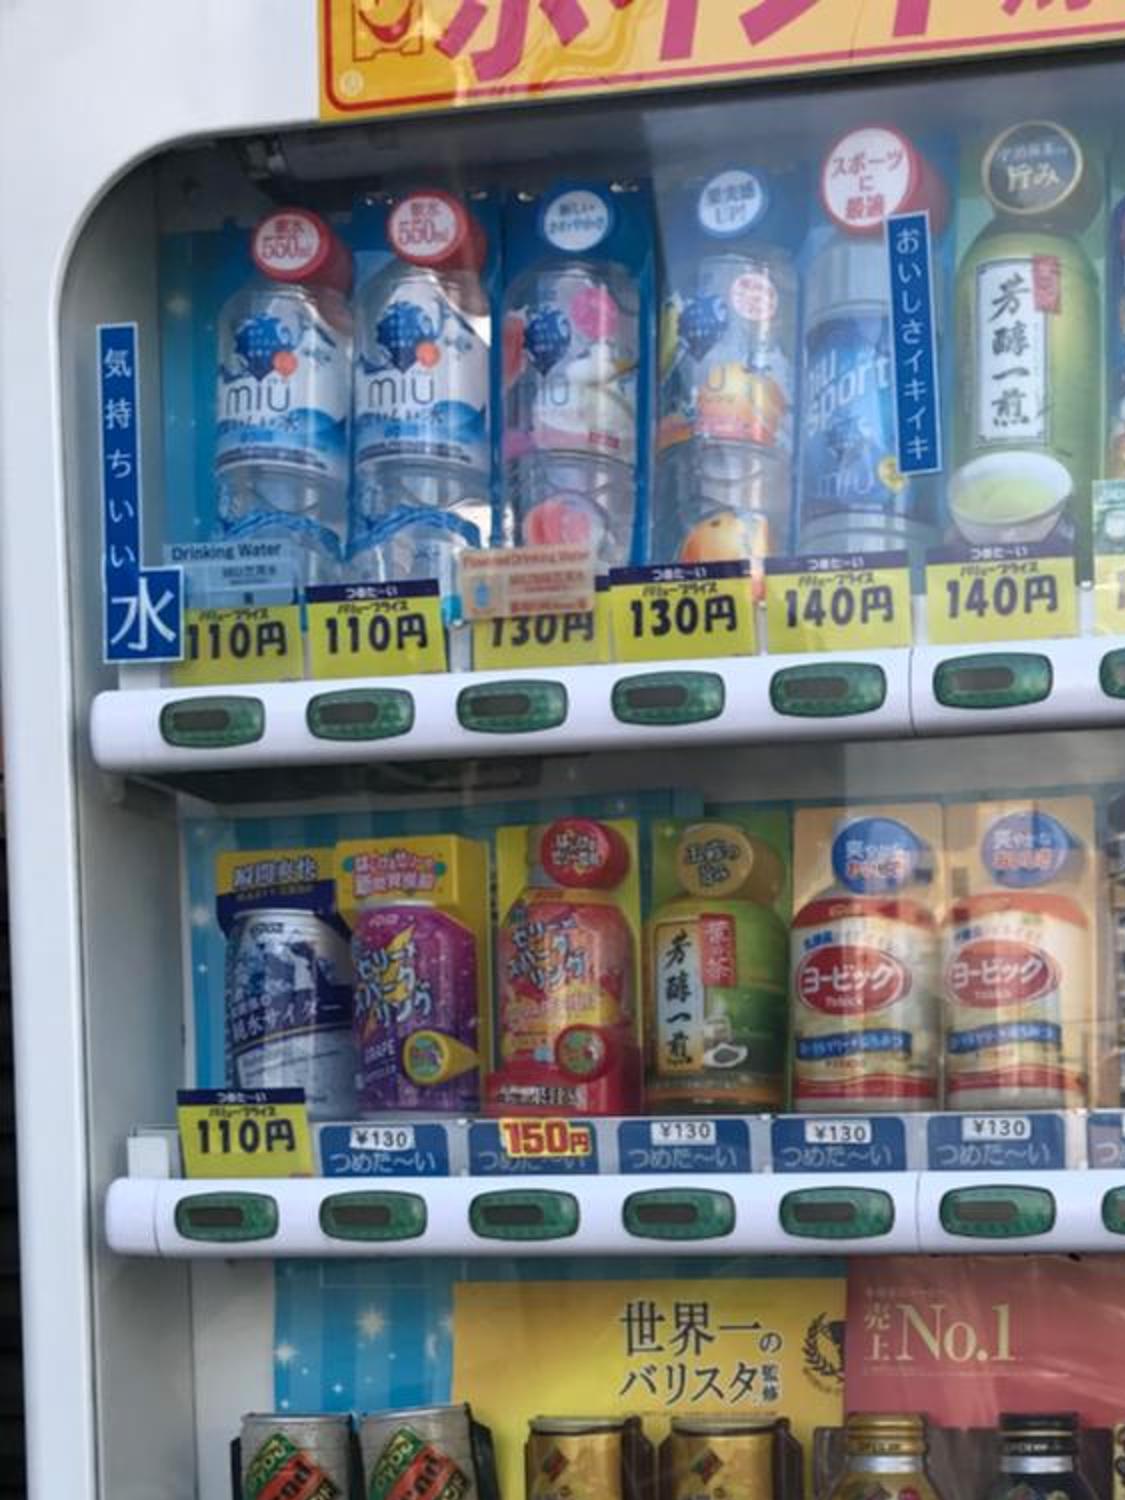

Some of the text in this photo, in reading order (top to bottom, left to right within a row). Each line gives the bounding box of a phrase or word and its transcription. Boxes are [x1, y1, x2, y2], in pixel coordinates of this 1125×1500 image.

[831, 149, 904, 178] スポーツ
[858, 175, 874, 191] に
[895, 229, 930, 460] おいしさイキイキ
[991, 276, 1030, 428] 芳醇一煎
[103, 348, 177, 651] 気持ちいい 水
[171, 541, 282, 560] Drinking Water
[630, 595, 737, 638] 130円
[785, 586, 895, 628] 140円
[946, 575, 1059, 619] 140円
[187, 621, 287, 660] 110円
[326, 612, 429, 654] 110円
[197, 1118, 296, 1154] 110円
[354, 1129, 408, 1149] ¥130
[502, 1120, 591, 1156] 150円
[658, 1123, 712, 1139] ¥130
[815, 1124, 867, 1142] ¥130
[974, 1119, 1027, 1137] ¥130
[620, 1301, 783, 1357] 世界一の
[896, 1302, 1017, 1363] No.1
